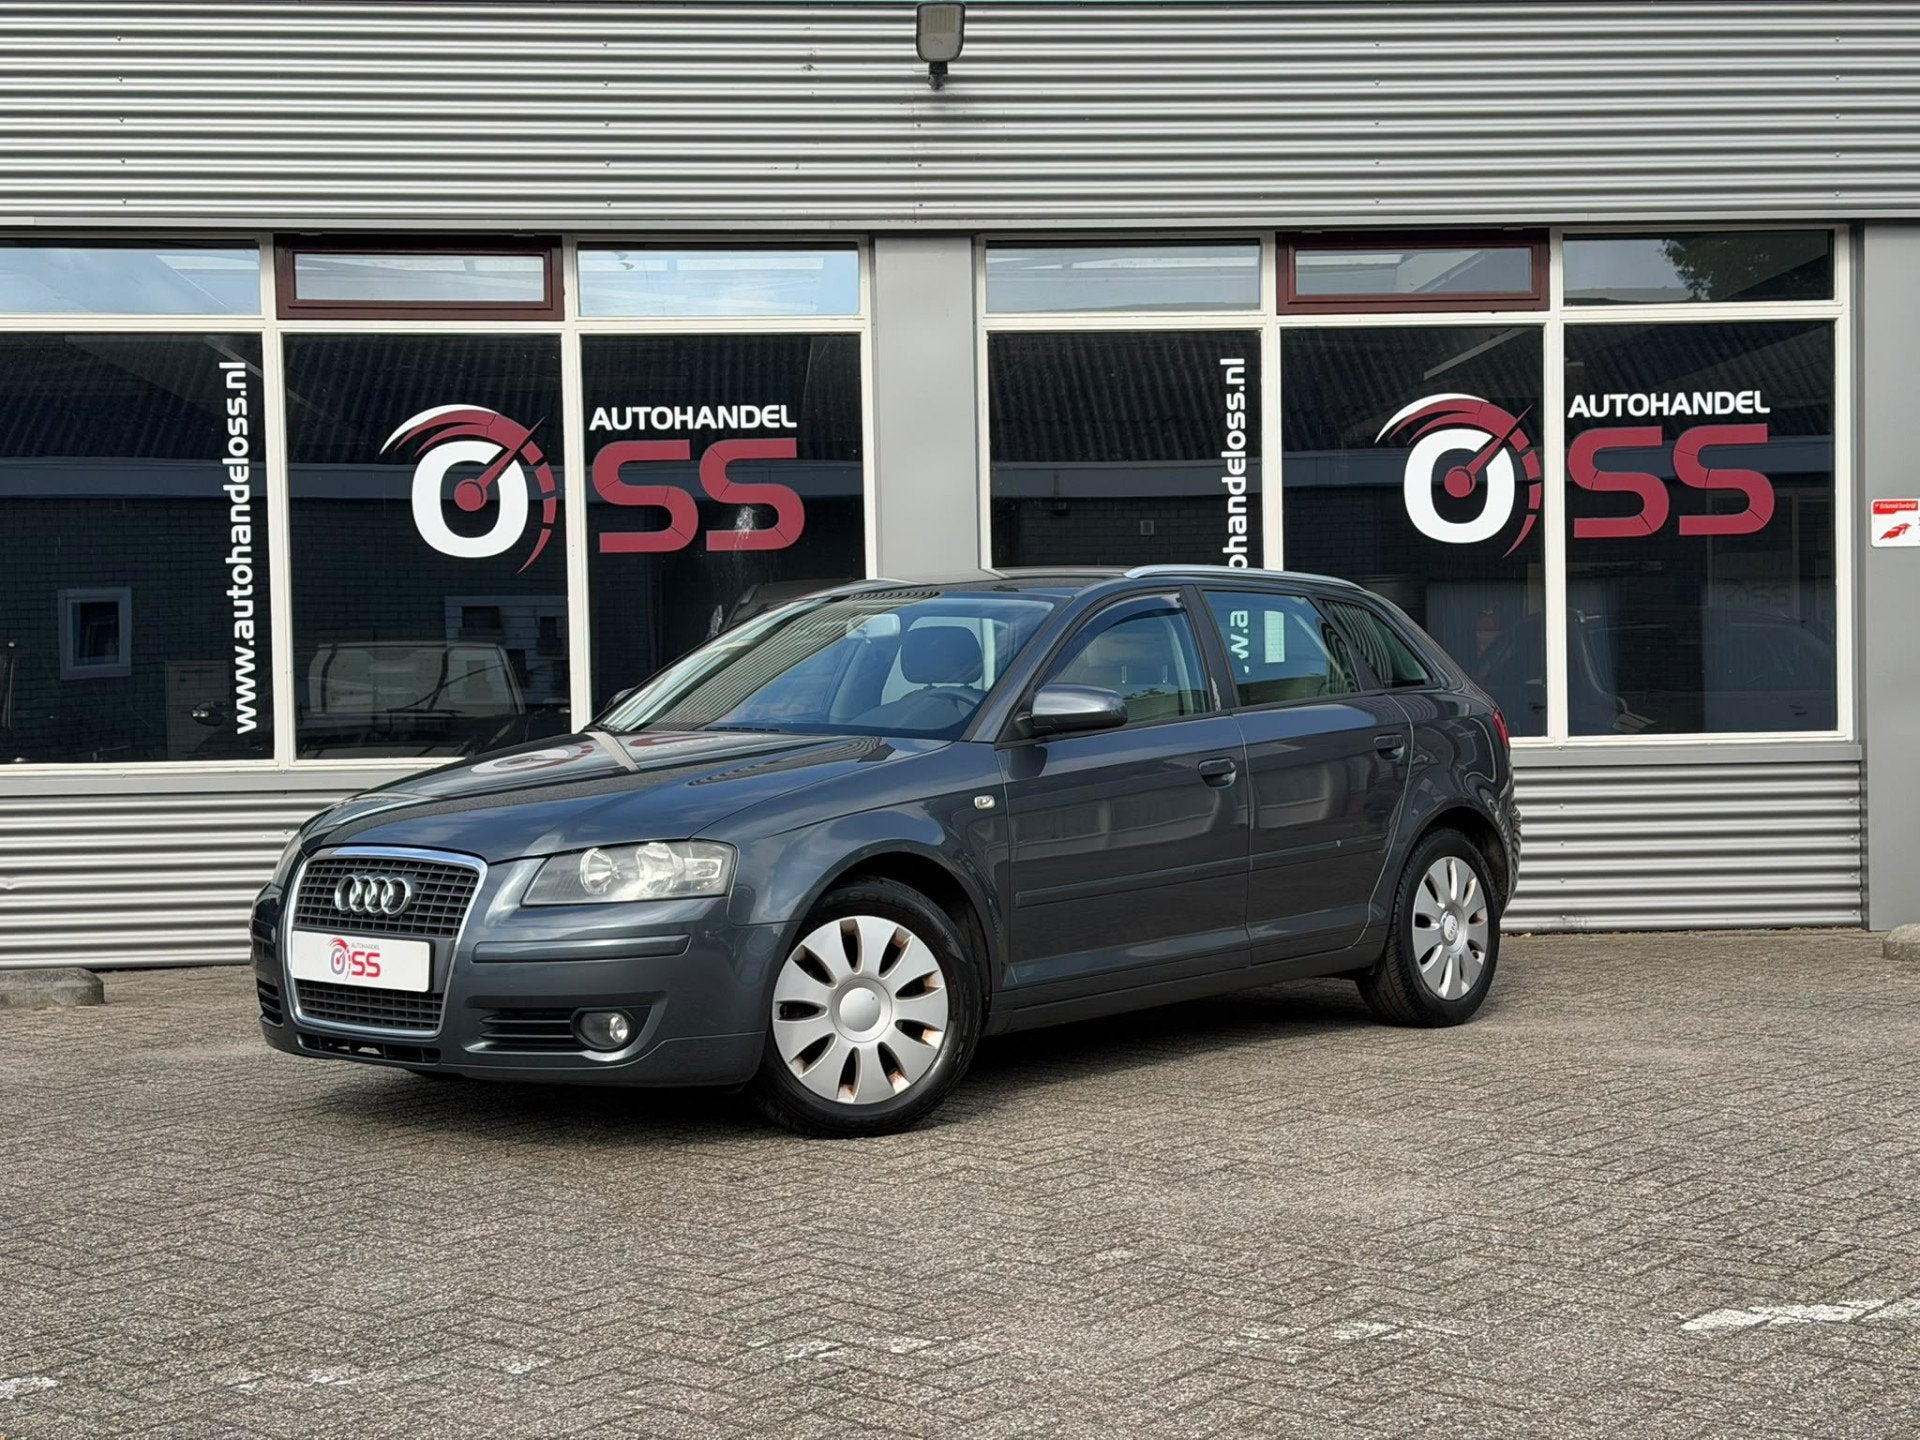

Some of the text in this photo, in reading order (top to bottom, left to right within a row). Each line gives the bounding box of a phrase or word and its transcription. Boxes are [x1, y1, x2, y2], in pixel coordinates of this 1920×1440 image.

[589, 404, 798, 431] AUTOHANDEL
[1567, 389, 1771, 418] AUTOHANDEL
[219, 361, 257, 735] www.autohandeloss.nl
